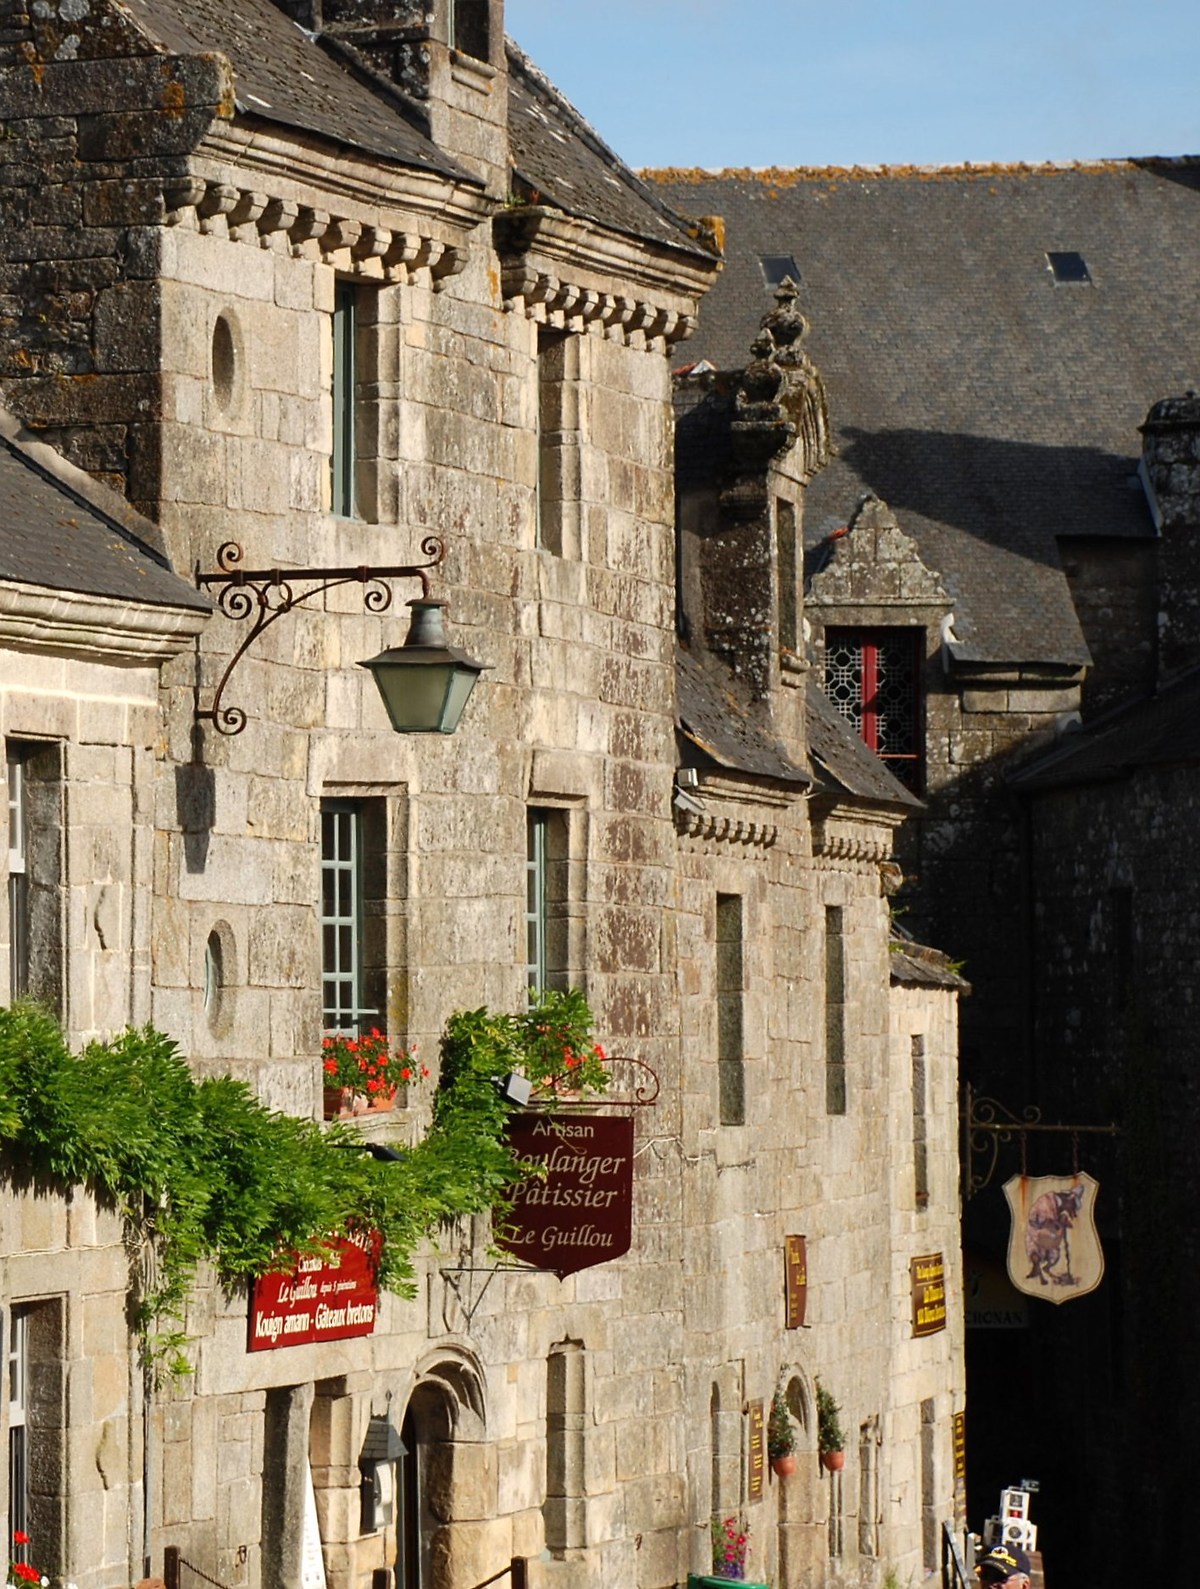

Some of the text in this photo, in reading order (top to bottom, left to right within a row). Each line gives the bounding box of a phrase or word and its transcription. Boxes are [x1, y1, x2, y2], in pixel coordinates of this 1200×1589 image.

[533, 1120, 595, 1138] Artisan
[506, 1181, 618, 1208] Pâtissier
[509, 1224, 614, 1251] Le Guillou
[277, 1282, 289, 1303] Le
[289, 1276, 318, 1308] Guillou
[256, 1311, 284, 1343] Kouign
[284, 1312, 310, 1335] amann
[315, 1303, 346, 1330] Gâteaux
[347, 1300, 374, 1326] bretons
